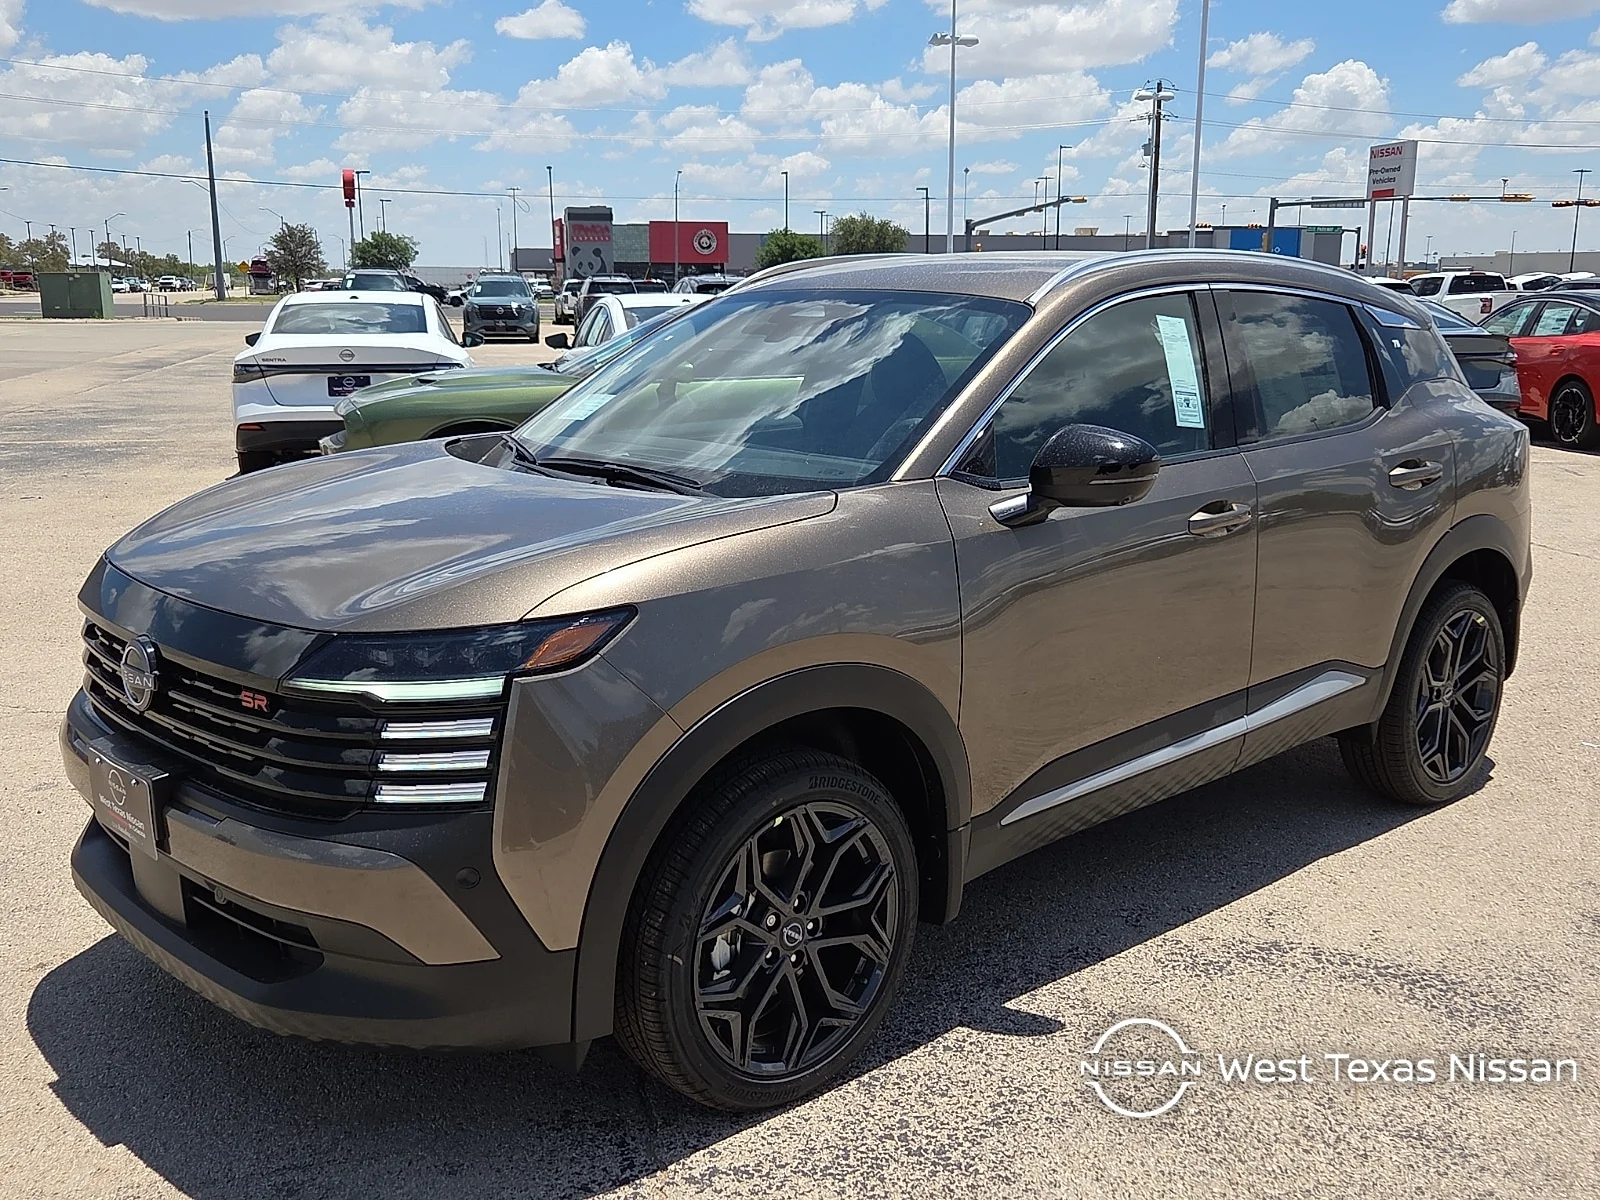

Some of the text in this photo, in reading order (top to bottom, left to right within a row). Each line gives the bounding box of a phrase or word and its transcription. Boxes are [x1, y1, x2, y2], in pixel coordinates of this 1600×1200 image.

[1370, 146, 1403, 159] NISSAN
[1369, 165, 1402, 176] Pre-Owned
[1372, 176, 1397, 185] Vehicles
[240, 689, 269, 712] SR
[808, 776, 881, 805] BRIDGESTONE
[111, 802, 127, 818] Texas
[126, 811, 145, 830] Nissan
